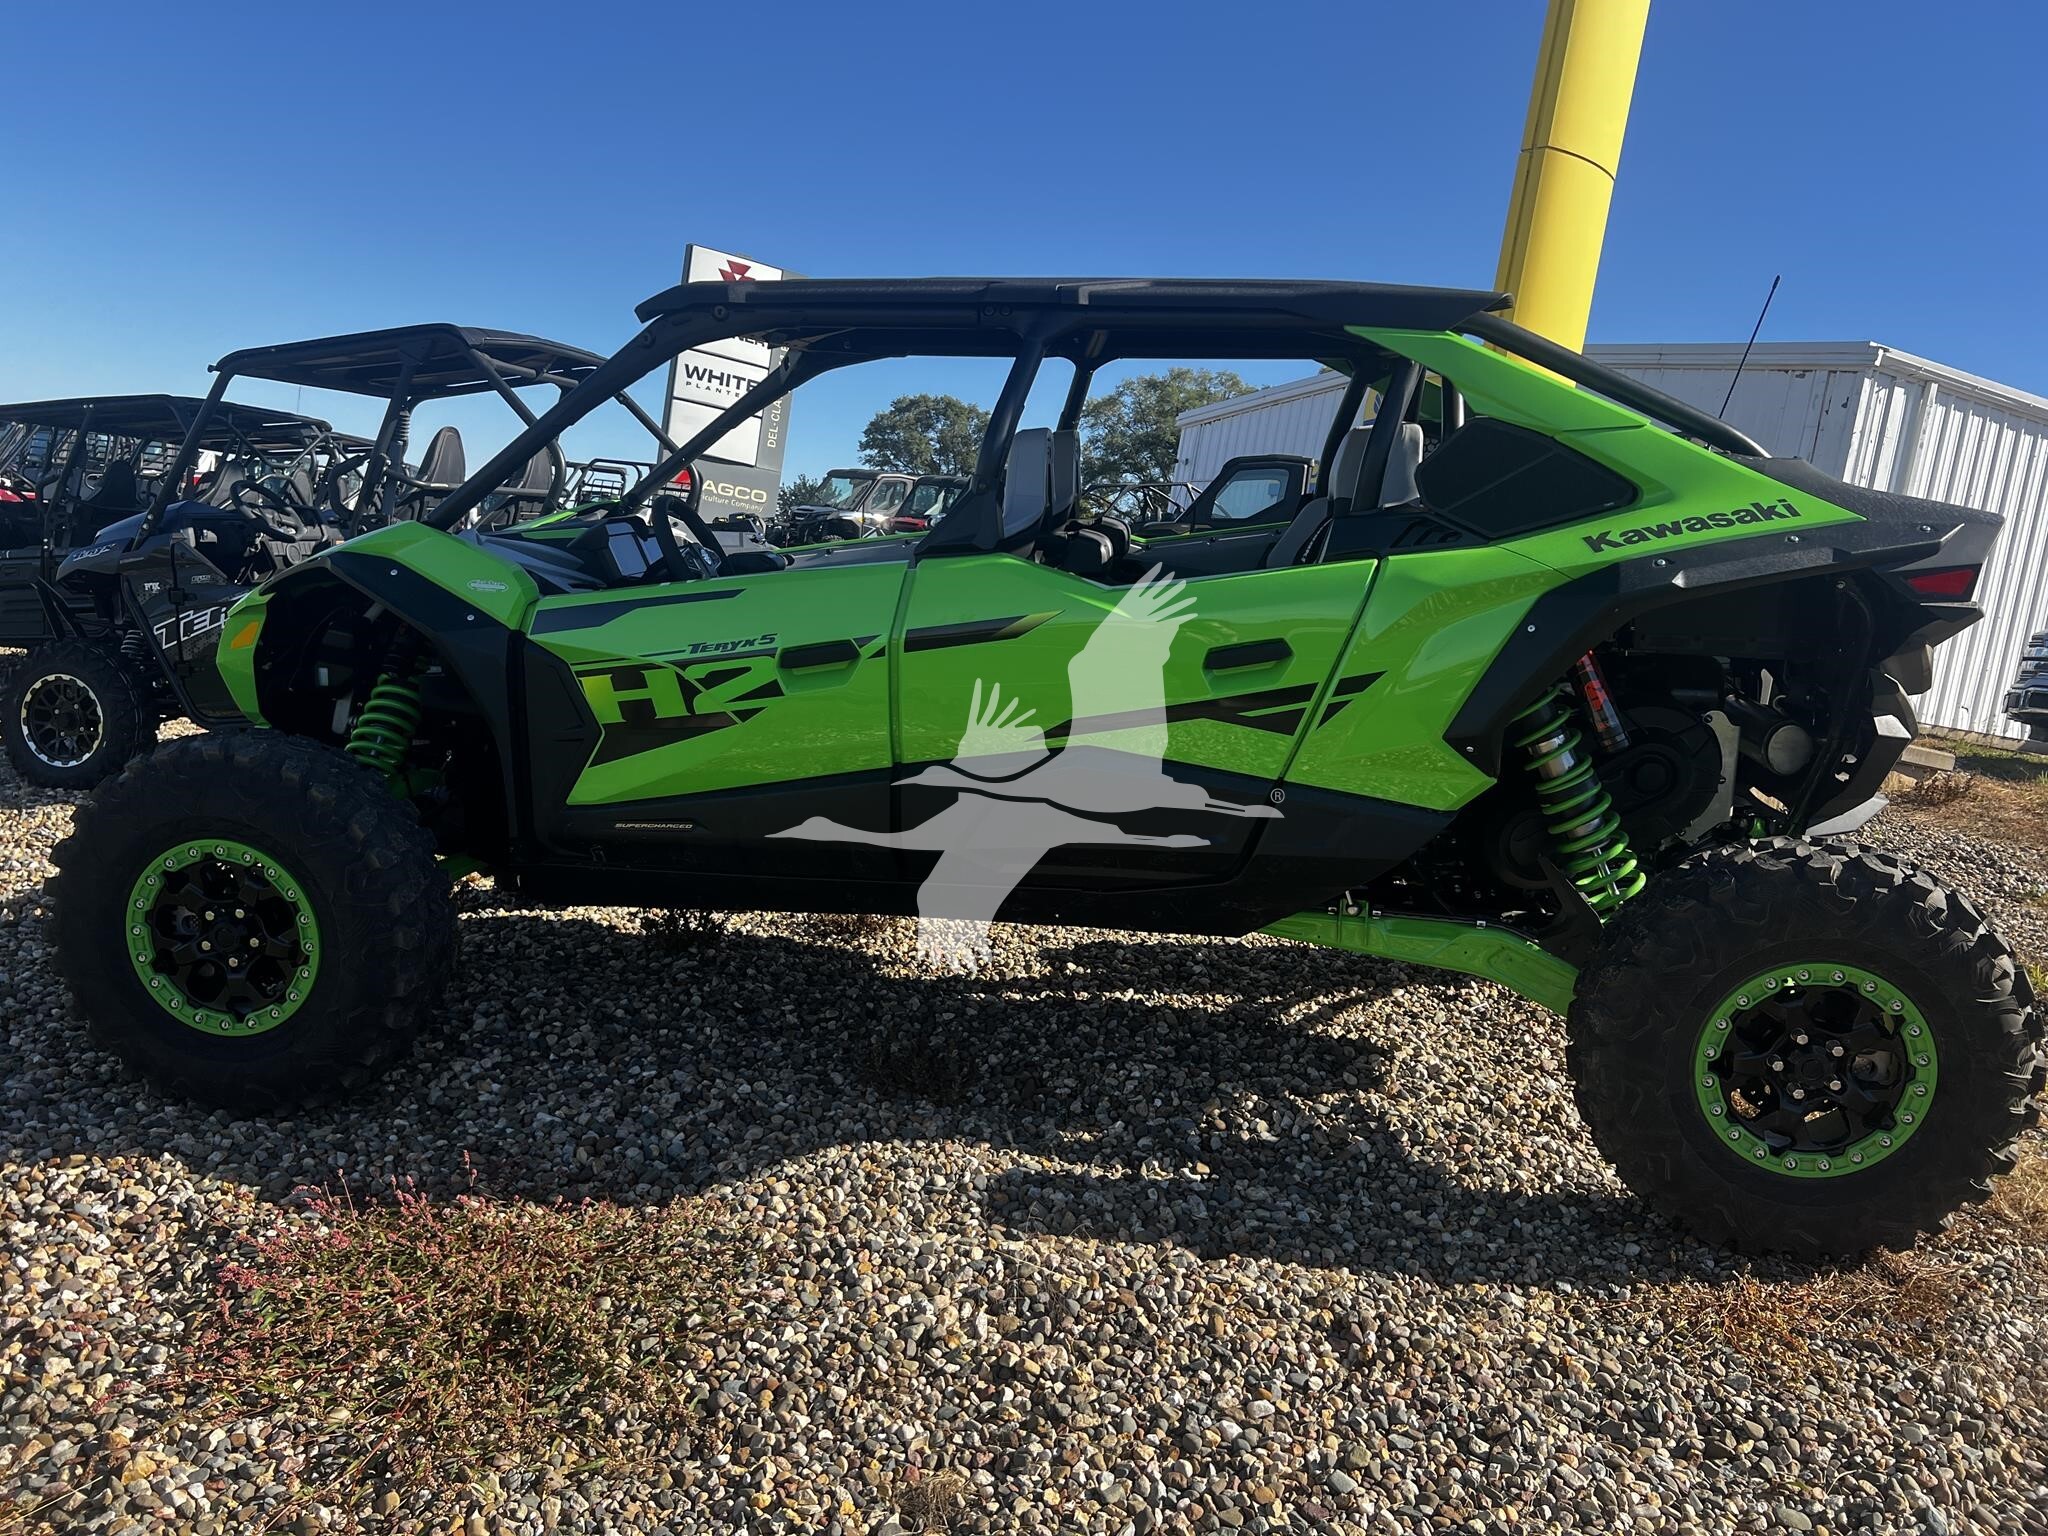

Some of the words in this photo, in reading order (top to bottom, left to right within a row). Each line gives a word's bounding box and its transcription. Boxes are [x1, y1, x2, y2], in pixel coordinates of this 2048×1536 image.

[684, 363, 761, 392] WHITE
[685, 381, 740, 398] PLANTE
[767, 397, 783, 448] DEL-CLA
[702, 480, 767, 503] AGCO
[702, 494, 730, 505] iculture
[731, 499, 764, 513] Company
[1582, 498, 1801, 553] Kawasaki
[578, 655, 783, 724] H2
[615, 822, 694, 830] SUPERCHARGED
